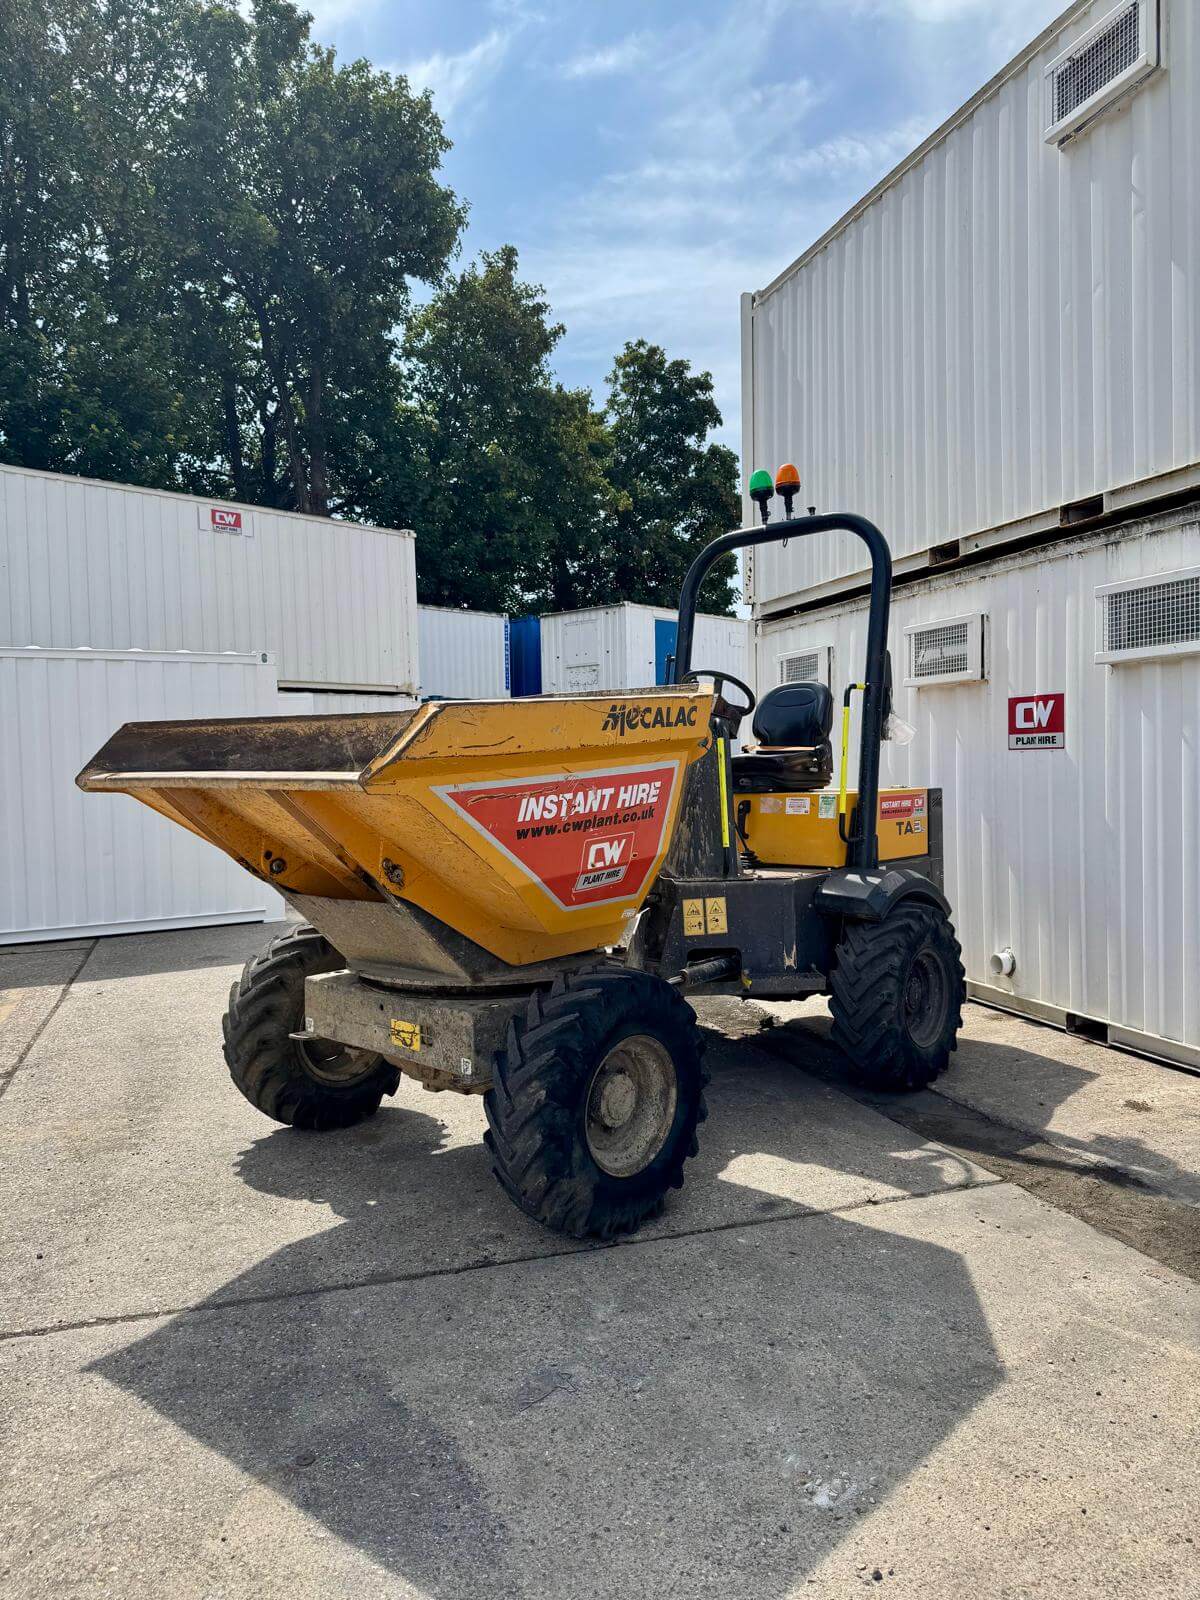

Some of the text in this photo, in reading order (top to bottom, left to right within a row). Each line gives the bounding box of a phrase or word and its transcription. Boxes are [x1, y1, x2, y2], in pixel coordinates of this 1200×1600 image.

[215, 512, 236, 525] CW
[1015, 700, 1056, 729] CW
[1037, 735, 1057, 745] HIRE
[517, 781, 661, 822] INSTANT HIRE
[516, 806, 655, 840] www.cwplant.co.uk
[587, 839, 627, 870] CW
[582, 868, 622, 886] PLANT HIRE
